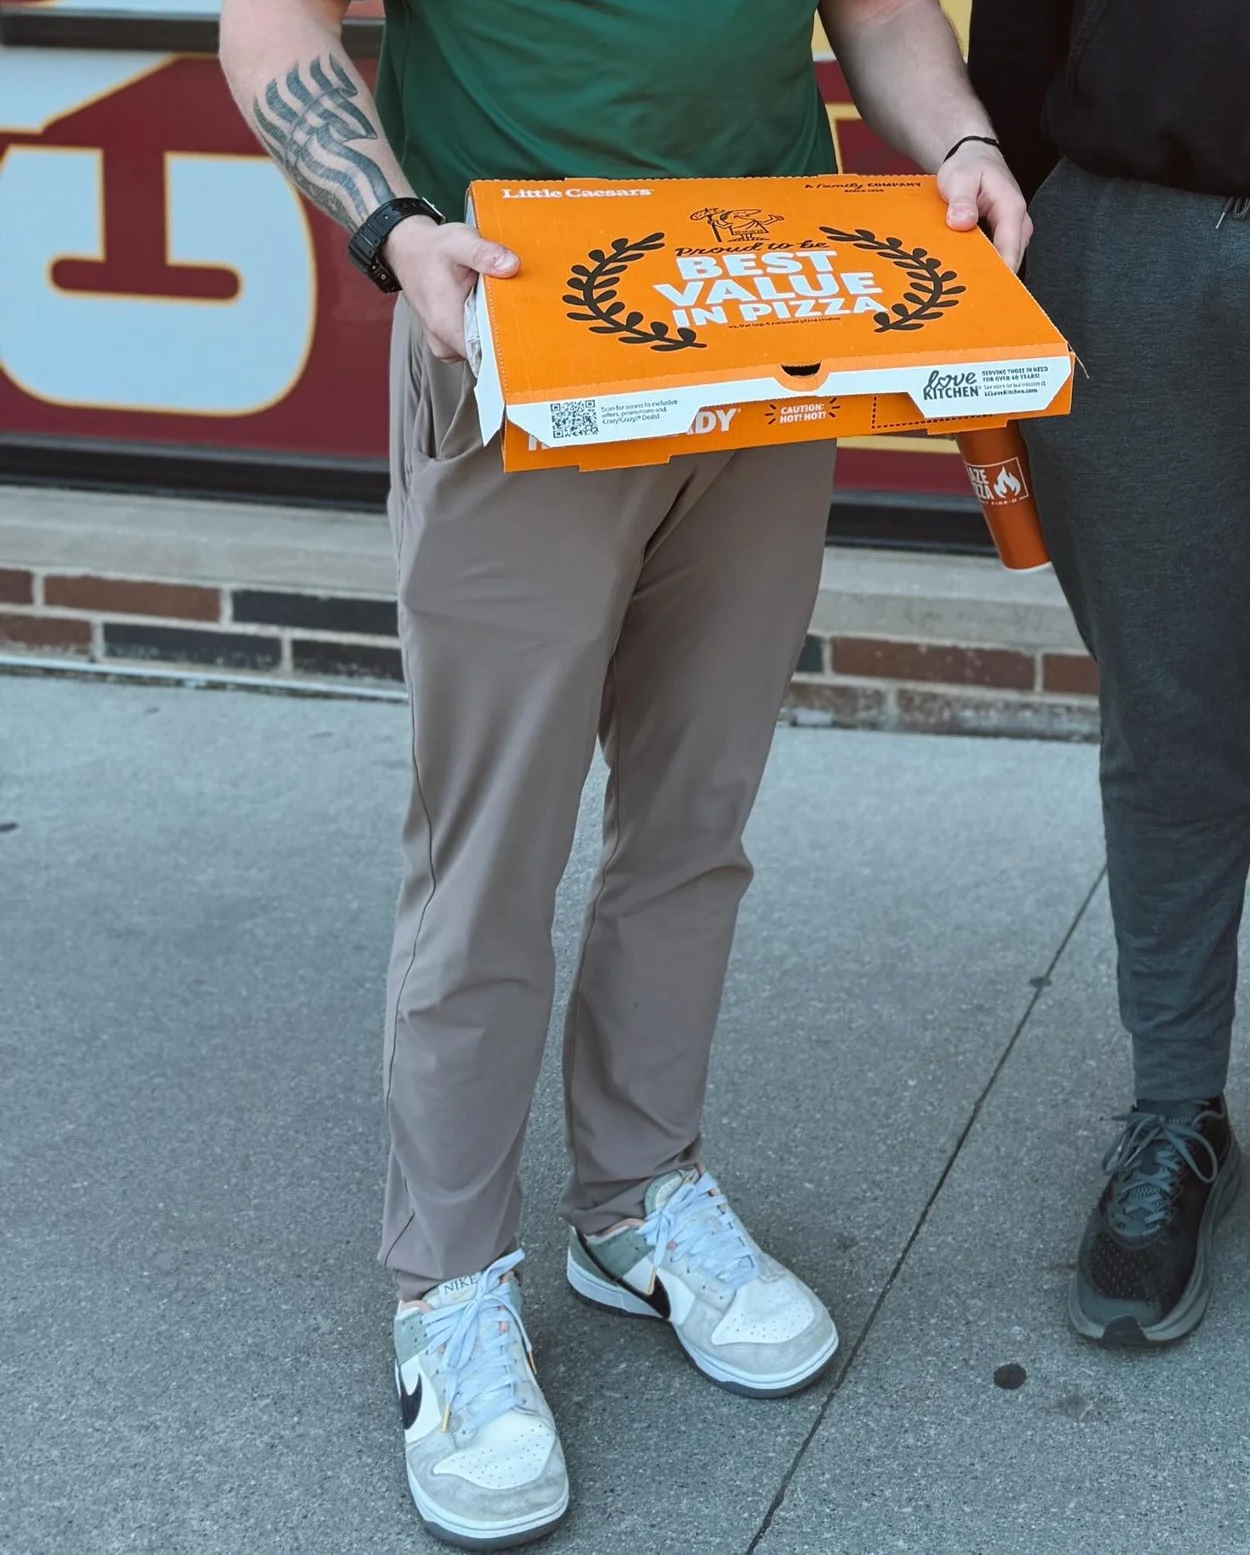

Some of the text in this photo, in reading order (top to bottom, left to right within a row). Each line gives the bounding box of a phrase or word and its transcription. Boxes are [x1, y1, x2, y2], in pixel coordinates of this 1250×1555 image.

[502, 187, 652, 199] Little Caesars
[674, 239, 831, 256] Proud to be
[675, 249, 838, 281] BEST
[653, 271, 884, 308] VALUE
[672, 296, 890, 328] IN PIZZA
[779, 411, 826, 424] HOT! HOT!
[780, 403, 825, 415] CAUTION:
[443, 1274, 477, 1295] NIKE
